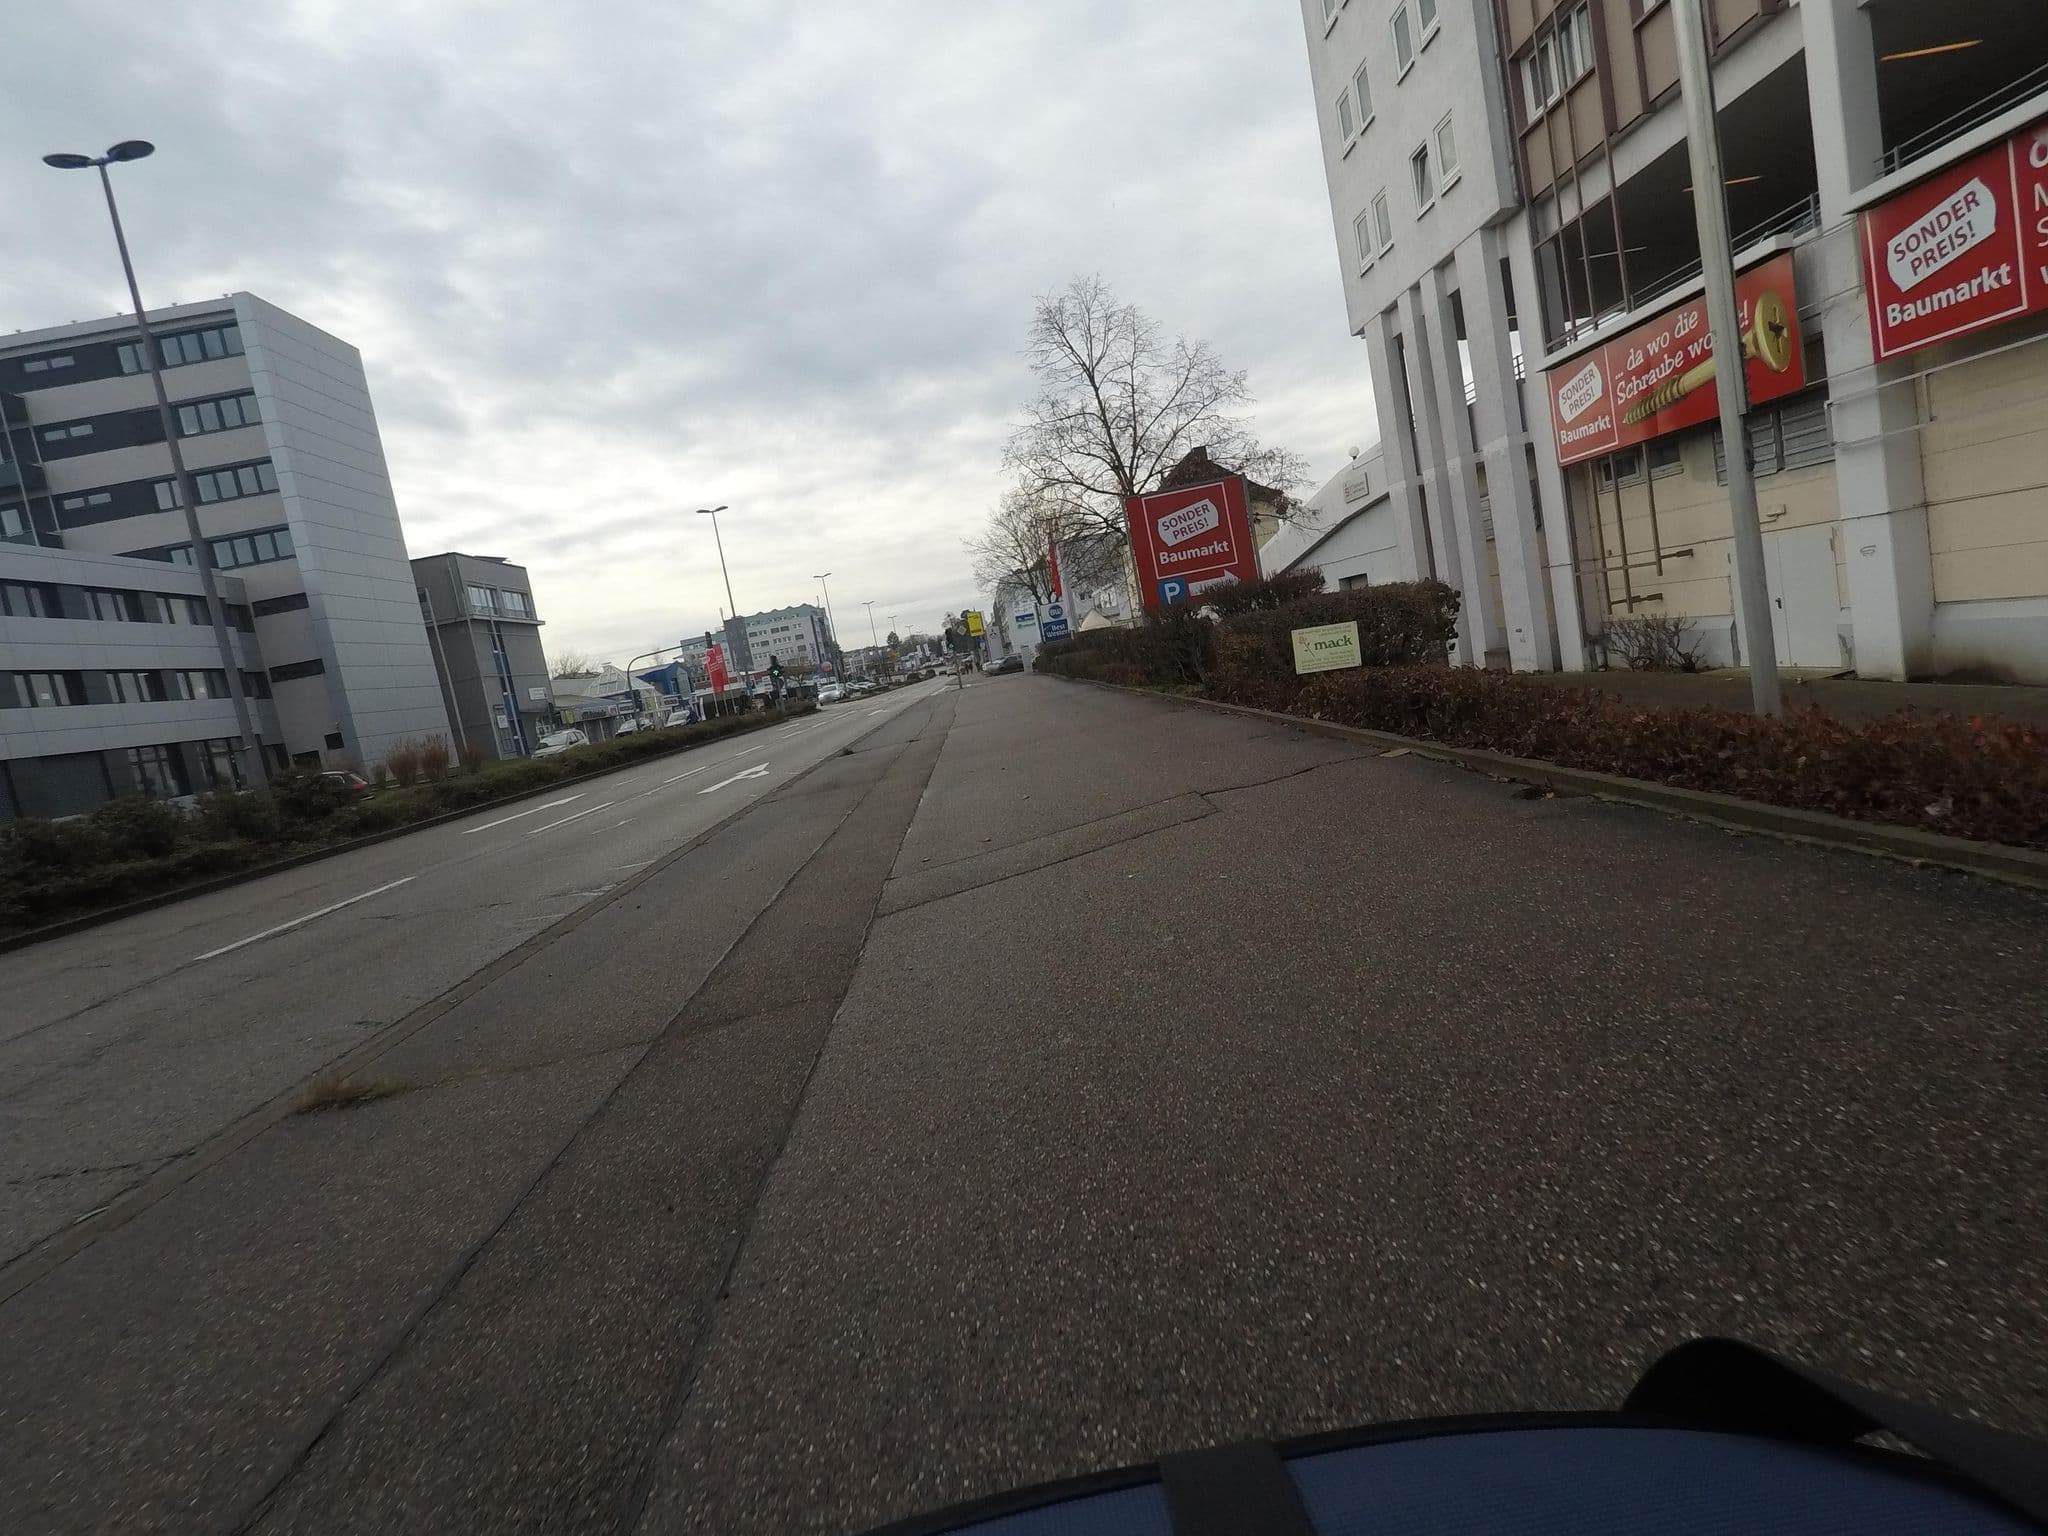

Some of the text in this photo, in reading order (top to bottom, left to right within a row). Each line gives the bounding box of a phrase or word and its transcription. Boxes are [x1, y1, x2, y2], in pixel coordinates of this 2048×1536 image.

[1893, 190, 1981, 263] SONDER
[1909, 220, 1976, 277] PREIS!
[1886, 263, 2012, 328] Baumarkt
[1627, 348, 1645, 371] da
[1647, 331, 1670, 357] wo
[1674, 311, 1698, 339] die
[1561, 370, 1596, 405] SONDER
[1616, 350, 1684, 405] Schraube
[1569, 390, 1595, 416] PREIS!
[1560, 415, 1611, 445] Baumarkt
[1162, 503, 1210, 531] SONDER
[1172, 518, 1209, 540] PREIS!
[1159, 541, 1230, 565] Baumarkt
[1314, 634, 1353, 651] mack
